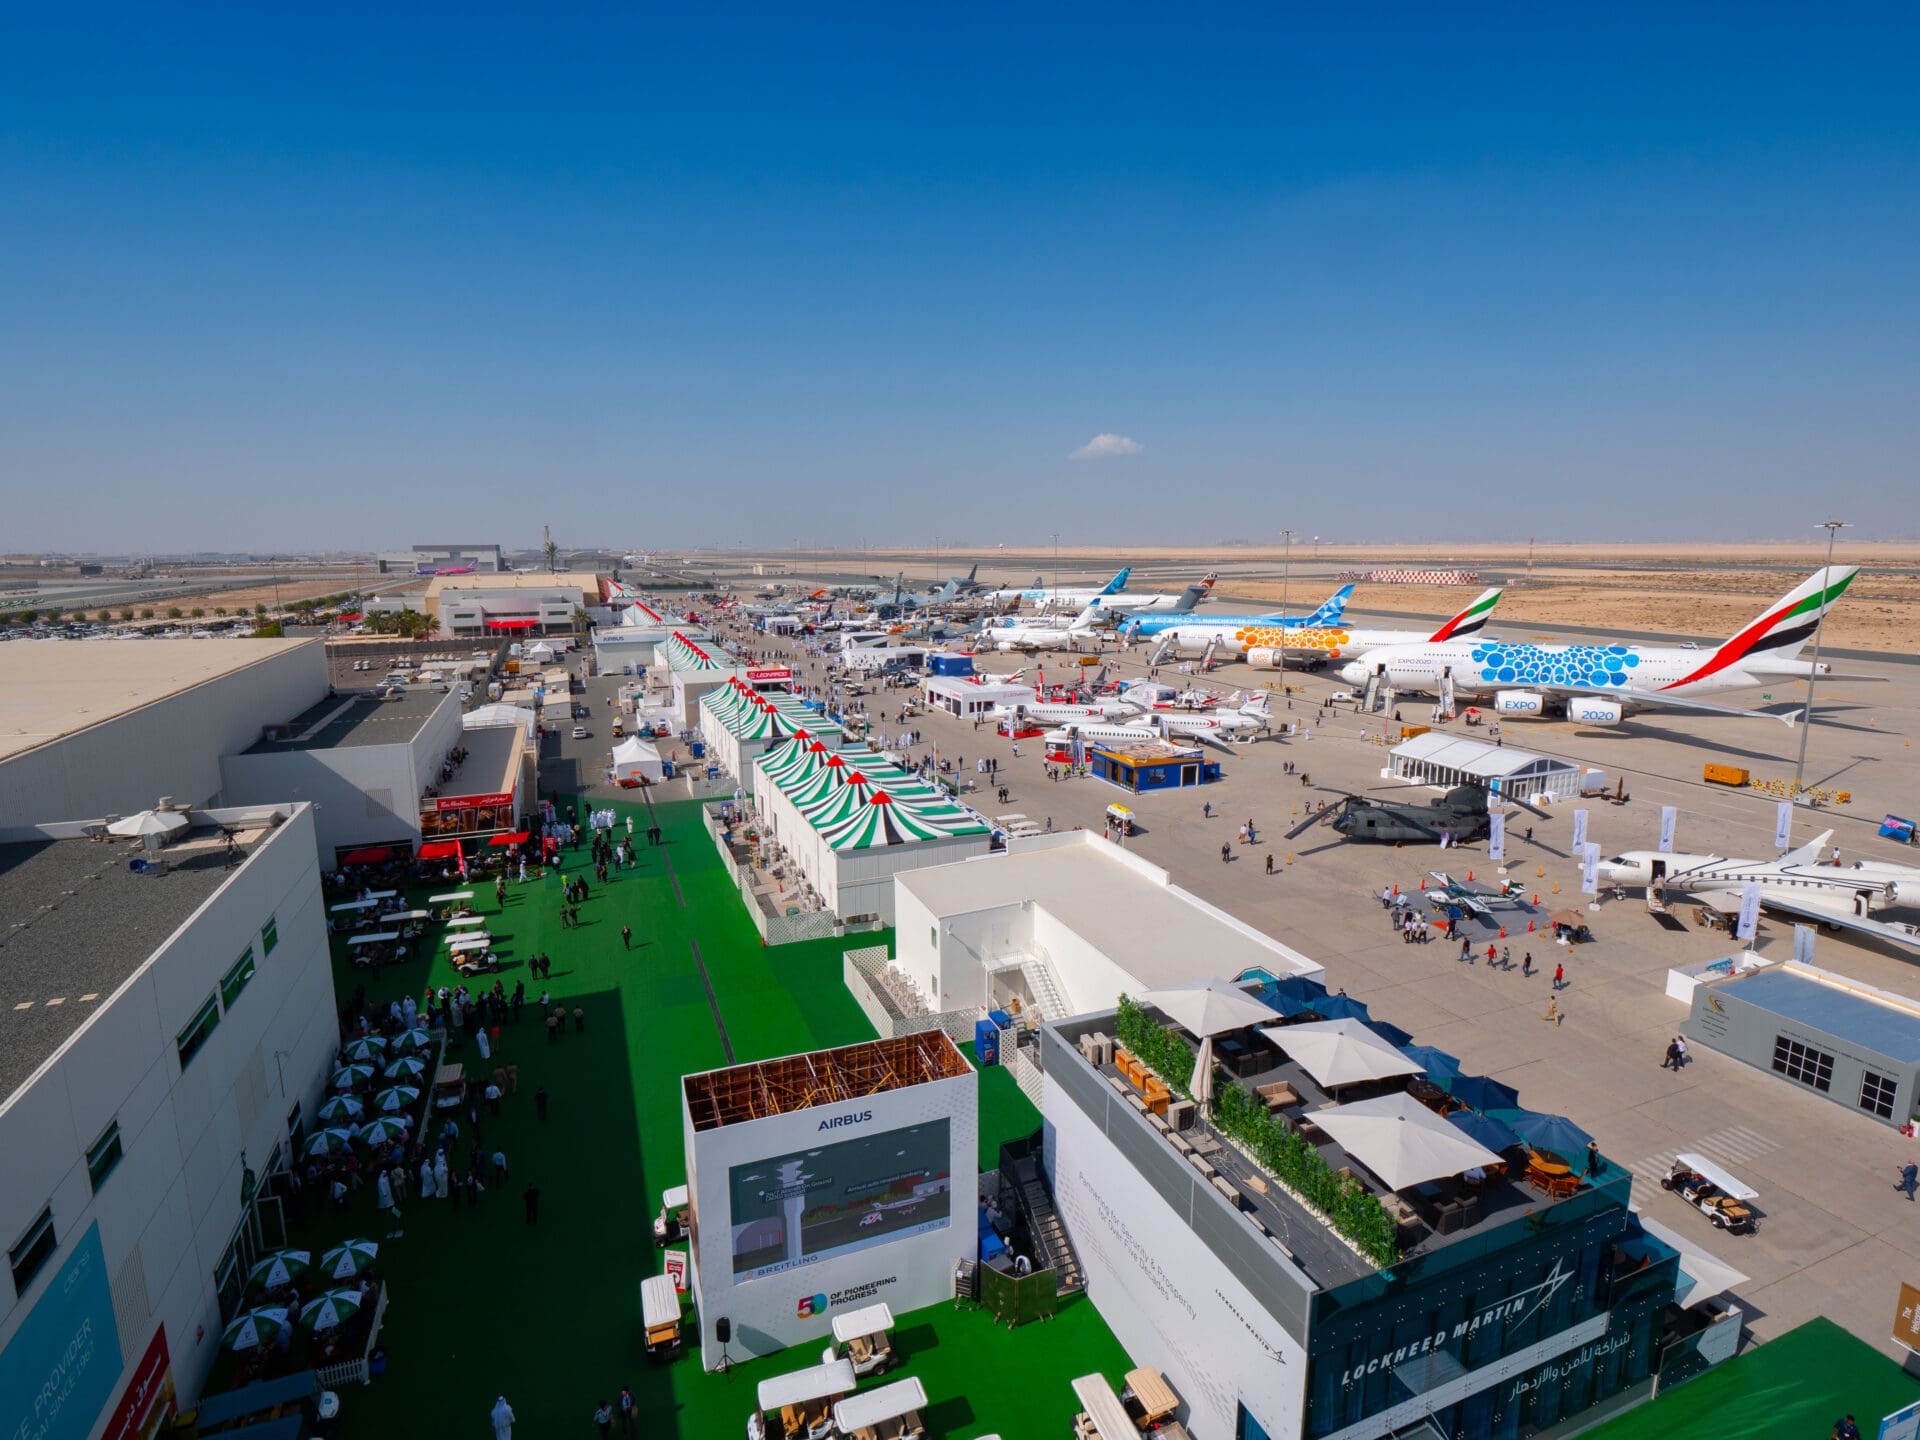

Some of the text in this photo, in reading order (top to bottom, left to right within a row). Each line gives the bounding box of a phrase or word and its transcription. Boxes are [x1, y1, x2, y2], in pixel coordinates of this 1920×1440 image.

[1056, 597, 1075, 606] FIJI
[756, 671, 788, 679] LEONARDO
[1505, 700, 1537, 711] EXPO
[1581, 710, 1614, 721] 2020
[818, 1110, 872, 1132] AIRBUS
[1079, 1170, 1111, 1214] Partnering
[1120, 1222, 1150, 1262] Security
[1157, 1267, 1197, 1320] Prosperity
[757, 1256, 818, 1276] BREITLING
[830, 1290, 843, 1300] OF
[844, 1276, 897, 1297] PIONEERING
[1138, 1258, 1171, 1300] Decades
[830, 1288, 878, 1307] PROGRESS
[1214, 1287, 1270, 1352] LOCKHEED MARTIN
[1341, 1296, 1525, 1386] LOCKHEED MARTIN
[34, 1318, 93, 1416] PROVIDER
[1508, 1330, 1631, 1402] شراكة للأمن والازدهار
[50, 1378, 76, 1420] SINCE
